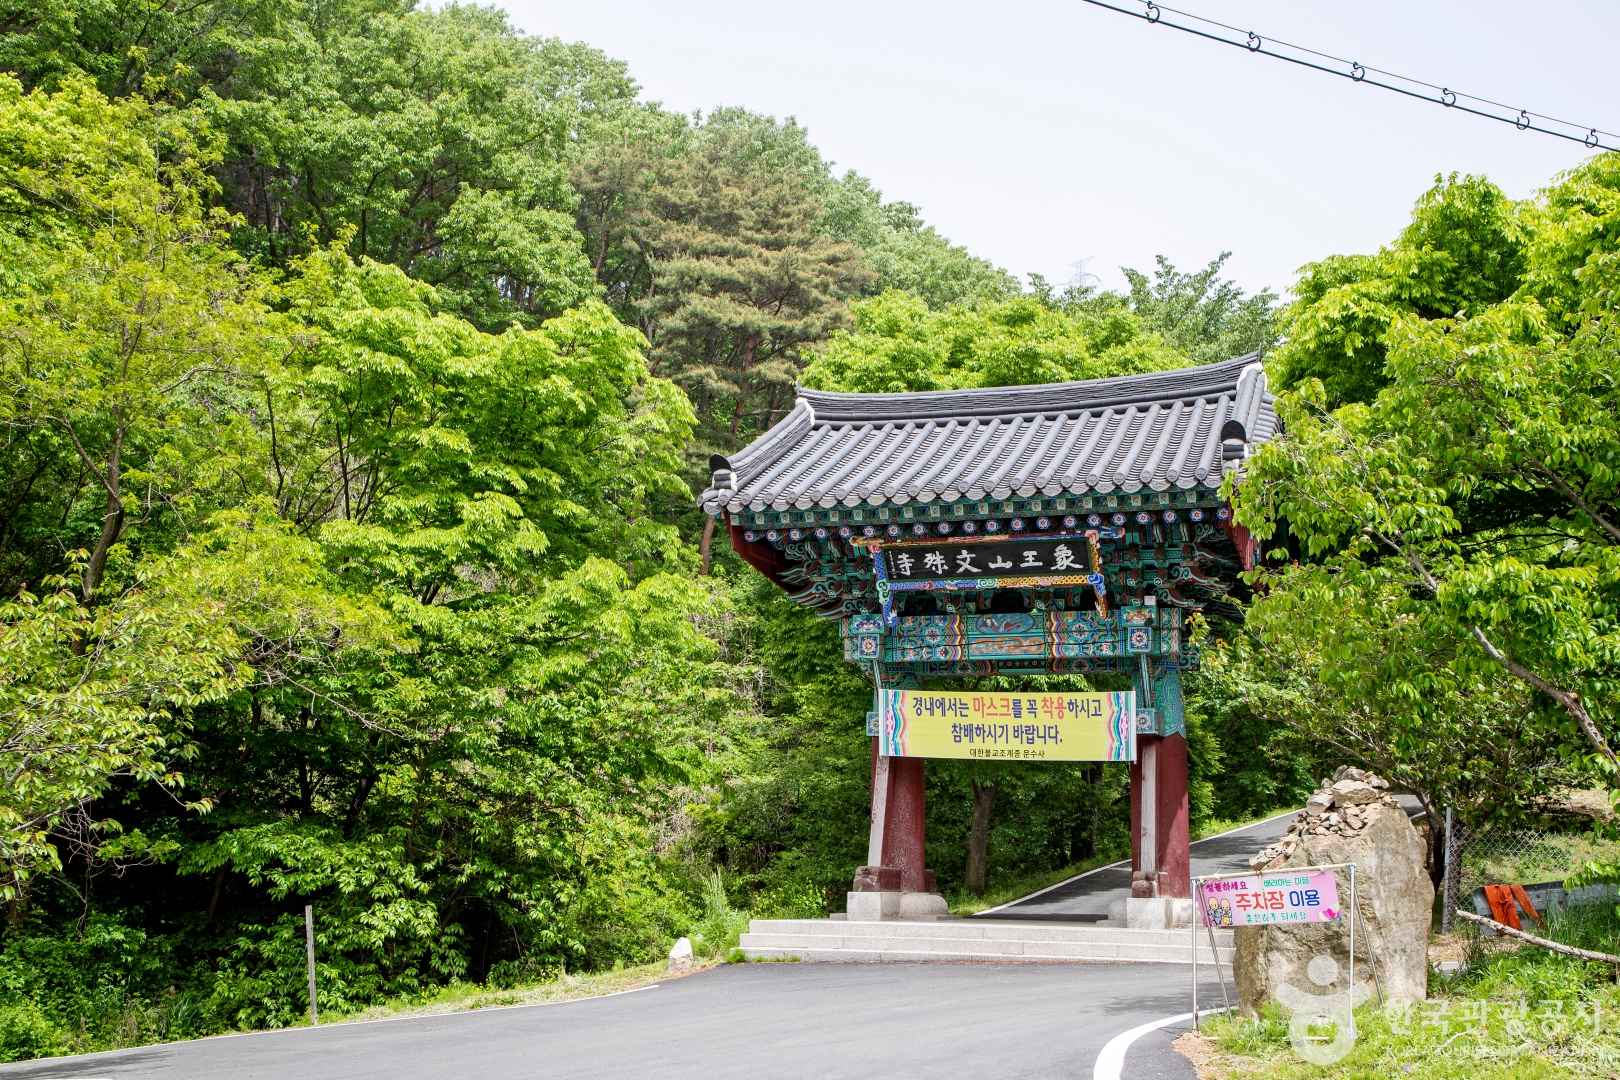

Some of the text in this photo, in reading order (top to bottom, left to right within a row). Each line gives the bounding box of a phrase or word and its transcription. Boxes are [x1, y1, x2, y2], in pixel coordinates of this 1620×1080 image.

[912, 697, 1103, 718] 경내에서는 마스크를 꼭 착용하시고
[951, 723, 1064, 745] 참배하시기 바랍니다.
[969, 748, 1046, 759] 대한불교조계종 문수사
[1235, 889, 1320, 911] 주차장 이용
